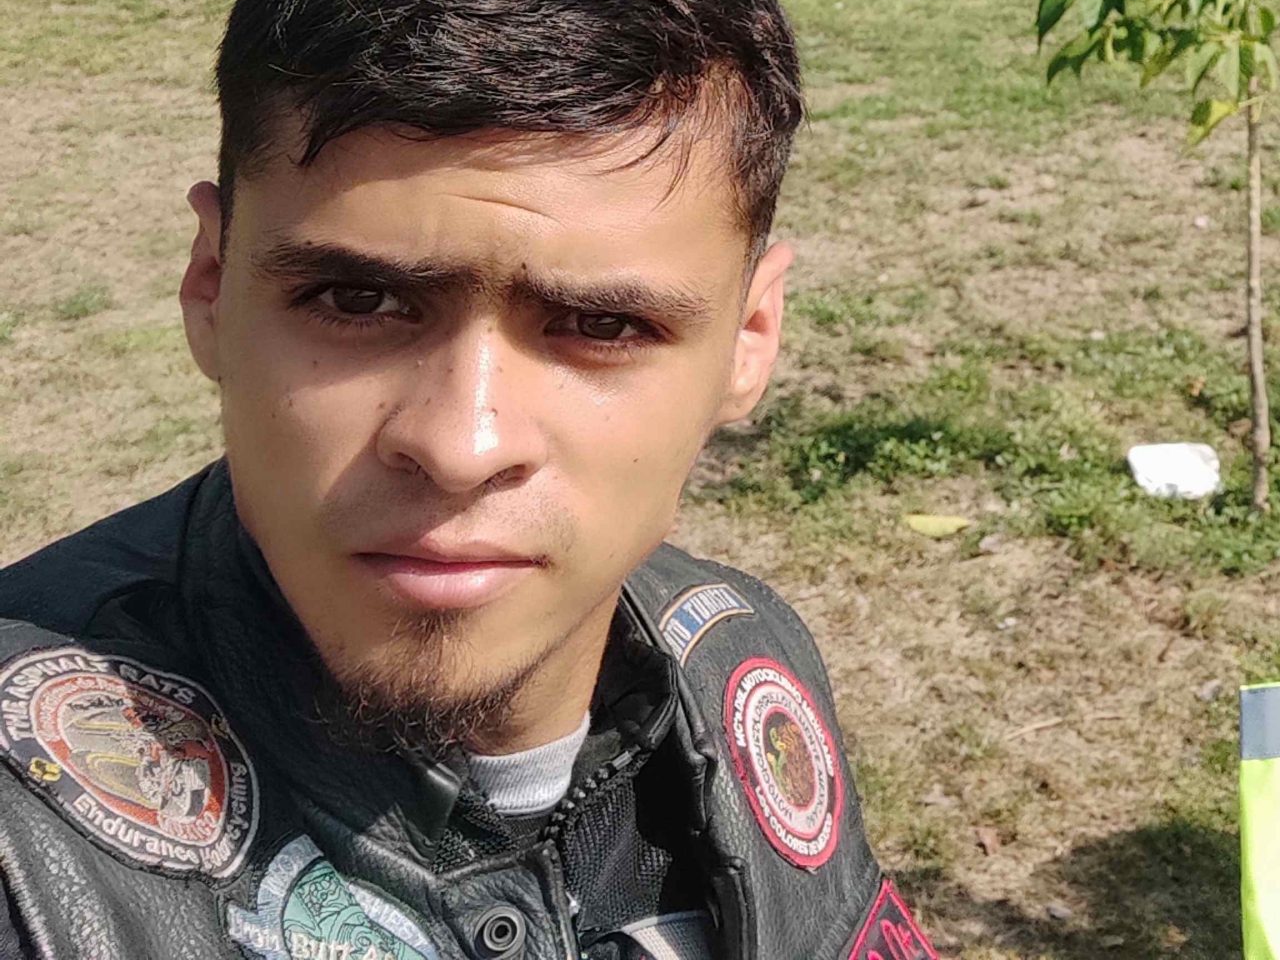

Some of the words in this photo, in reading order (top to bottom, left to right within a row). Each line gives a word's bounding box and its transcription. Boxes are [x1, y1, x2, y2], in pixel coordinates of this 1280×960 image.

[4, 655, 109, 700] ASPHALT
[119, 663, 196, 705] RATS
[2, 699, 35, 741] THE
[73, 794, 200, 864] Endurance
